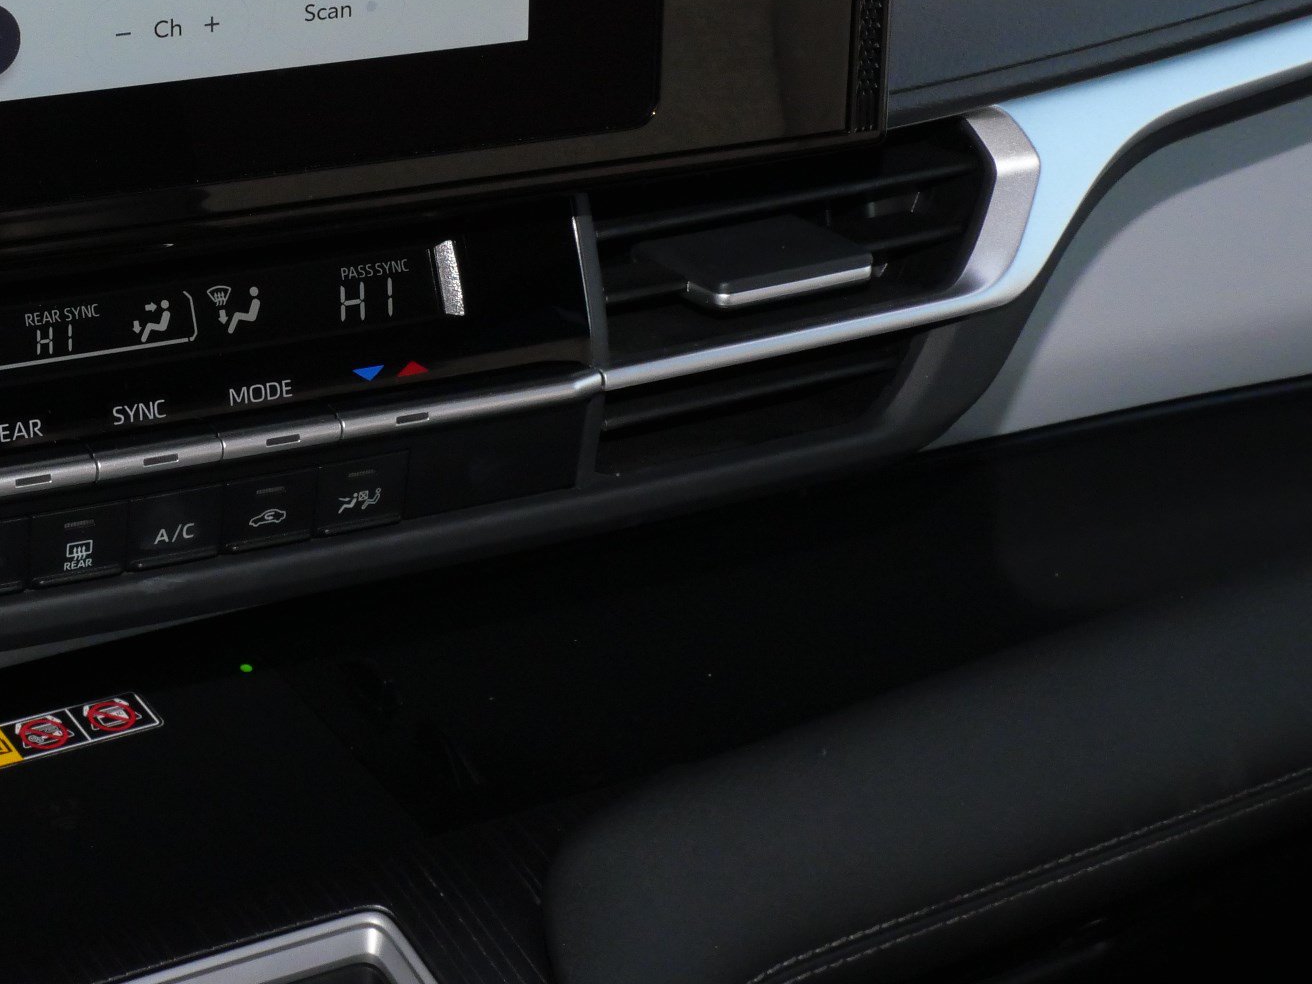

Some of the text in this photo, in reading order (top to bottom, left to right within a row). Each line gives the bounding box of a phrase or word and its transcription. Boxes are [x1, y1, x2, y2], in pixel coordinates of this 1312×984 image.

[304, 3, 353, 22] Scan
[153, 19, 183, 39] Ch
[341, 259, 409, 280] PASS SYNC
[25, 304, 100, 326] REAR SYNC
[229, 380, 293, 406] MODE
[112, 400, 167, 425] SYNC
[154, 523, 195, 544] A/C
[63, 559, 93, 571] REAR
